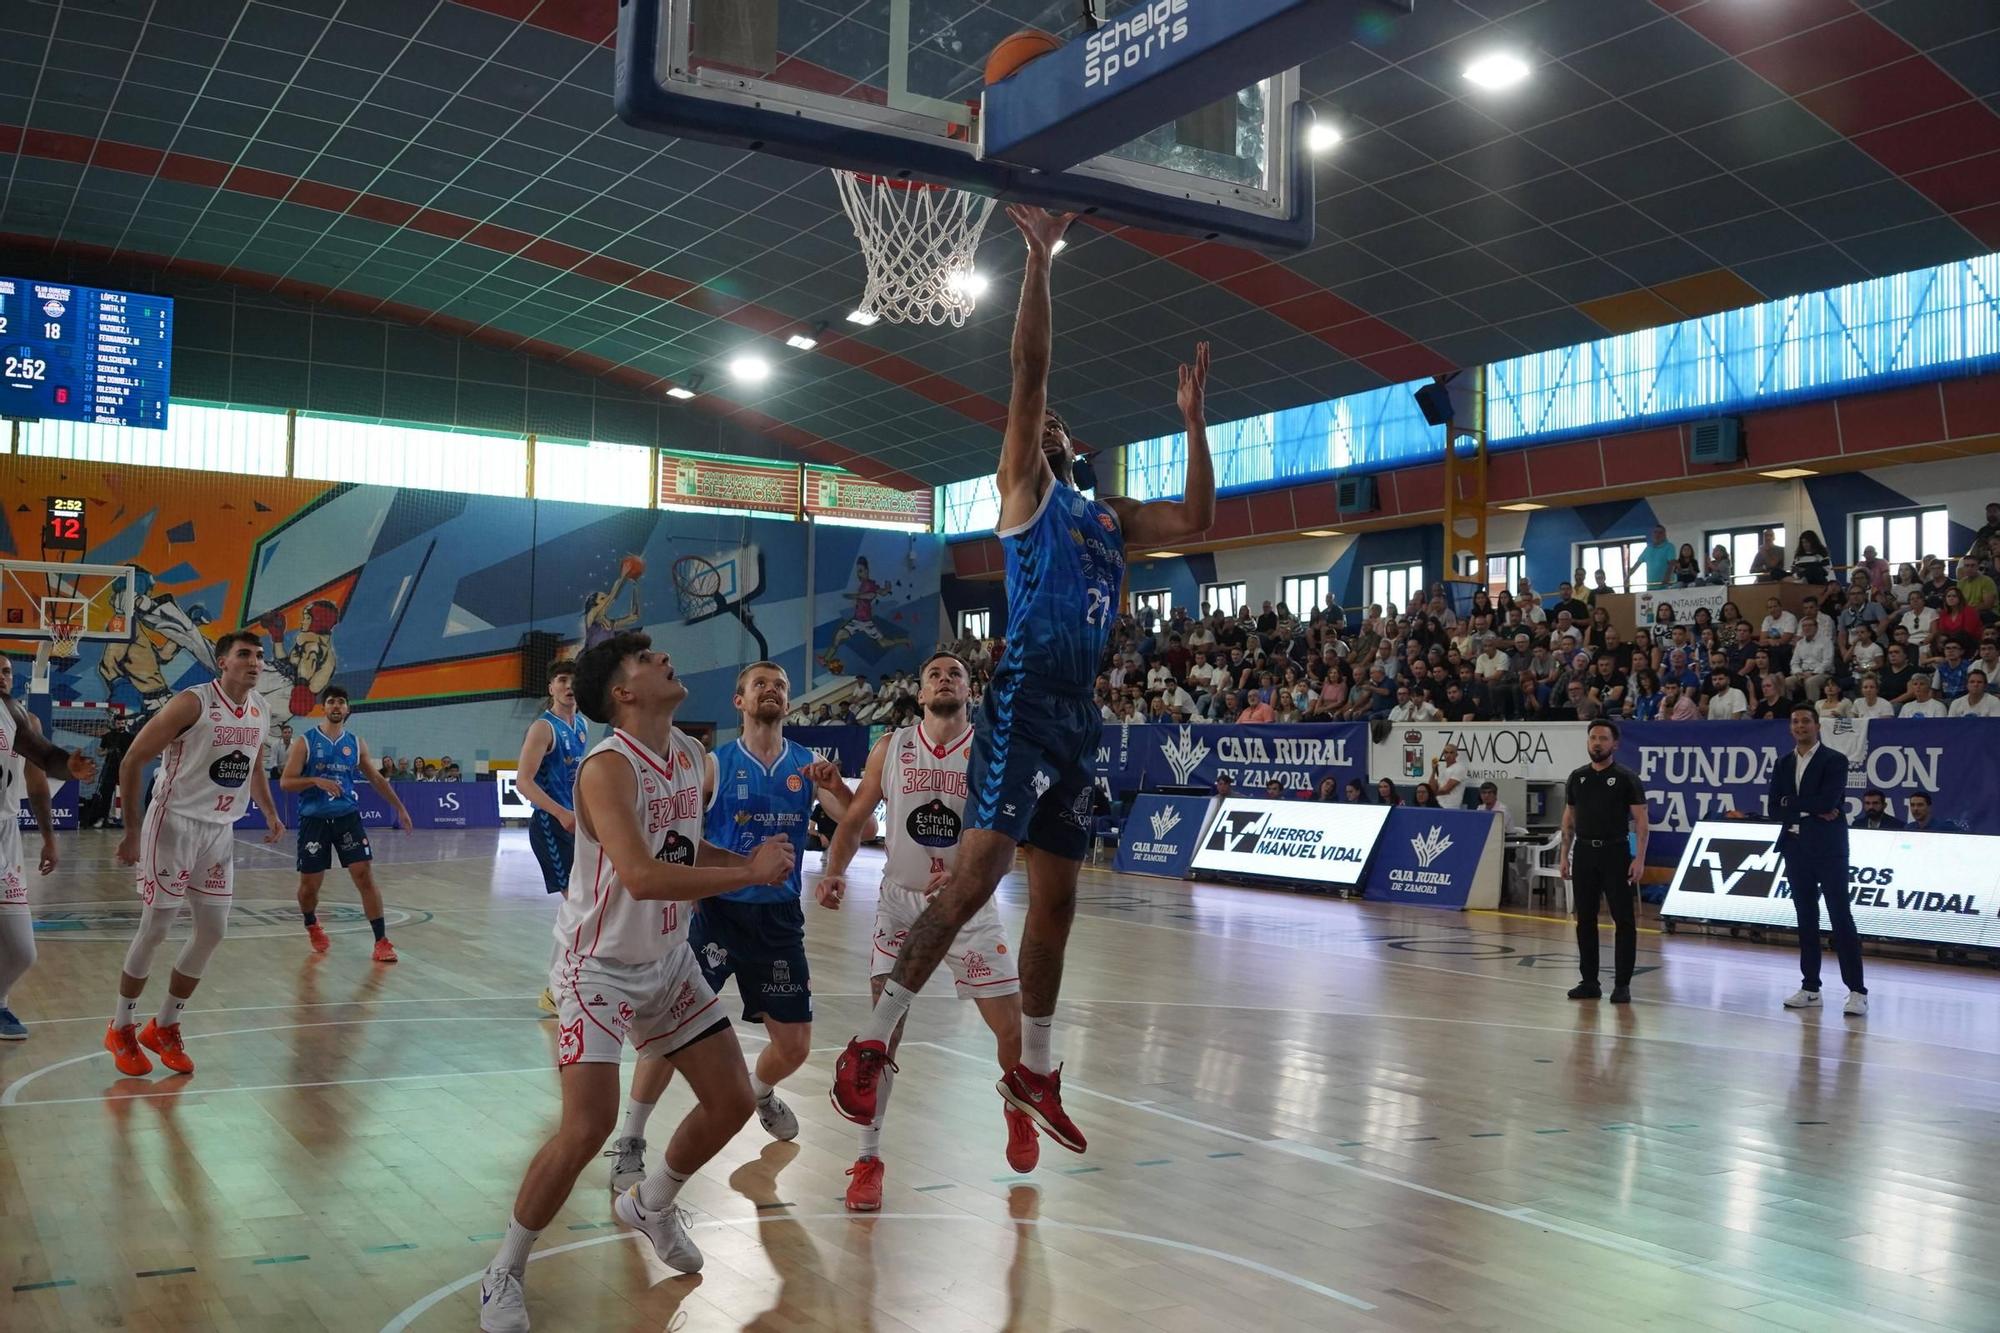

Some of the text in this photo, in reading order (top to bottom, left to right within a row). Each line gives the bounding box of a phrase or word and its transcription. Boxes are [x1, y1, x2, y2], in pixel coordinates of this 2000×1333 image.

[1085, 0, 1188, 61] Schelde
[1085, 17, 1188, 88] Sports
[44, 322, 61, 339] 18
[5, 356, 46, 381] 2:52
[702, 482, 784, 502] DE ZAMORA
[54, 499, 82, 511] 2:52
[862, 496, 918, 513] ZAMORA
[51, 517, 80, 539] 12
[1674, 608, 1721, 622] ZAMRA
[1216, 736, 1353, 767] CAJA RURAL
[1438, 730, 1554, 764] ZAMORA
[902, 767, 968, 799] 32005
[1214, 767, 1314, 791] DE ZAMORA
[1466, 770, 1509, 779] AMIENTO
[214, 795, 235, 812] 12
[359, 811, 382, 820] LATA
[915, 812, 955, 826] Estrella
[916, 823, 954, 838] Galicia
[1263, 826, 1325, 843] HIERROS
[1132, 842, 1179, 856] CAJA RURAL
[1256, 841, 1364, 863] MANUEL VIDAL
[1142, 854, 1168, 863] ZAMORA
[1389, 869, 1452, 886] CAJA RURAL
[1391, 882, 1438, 895] DE ZAMORA
[1897, 889, 1981, 916] VIDAL
[662, 902, 678, 934] 10
[701, 945, 727, 966] ZAMORA
[761, 983, 804, 993] ZAMORA
